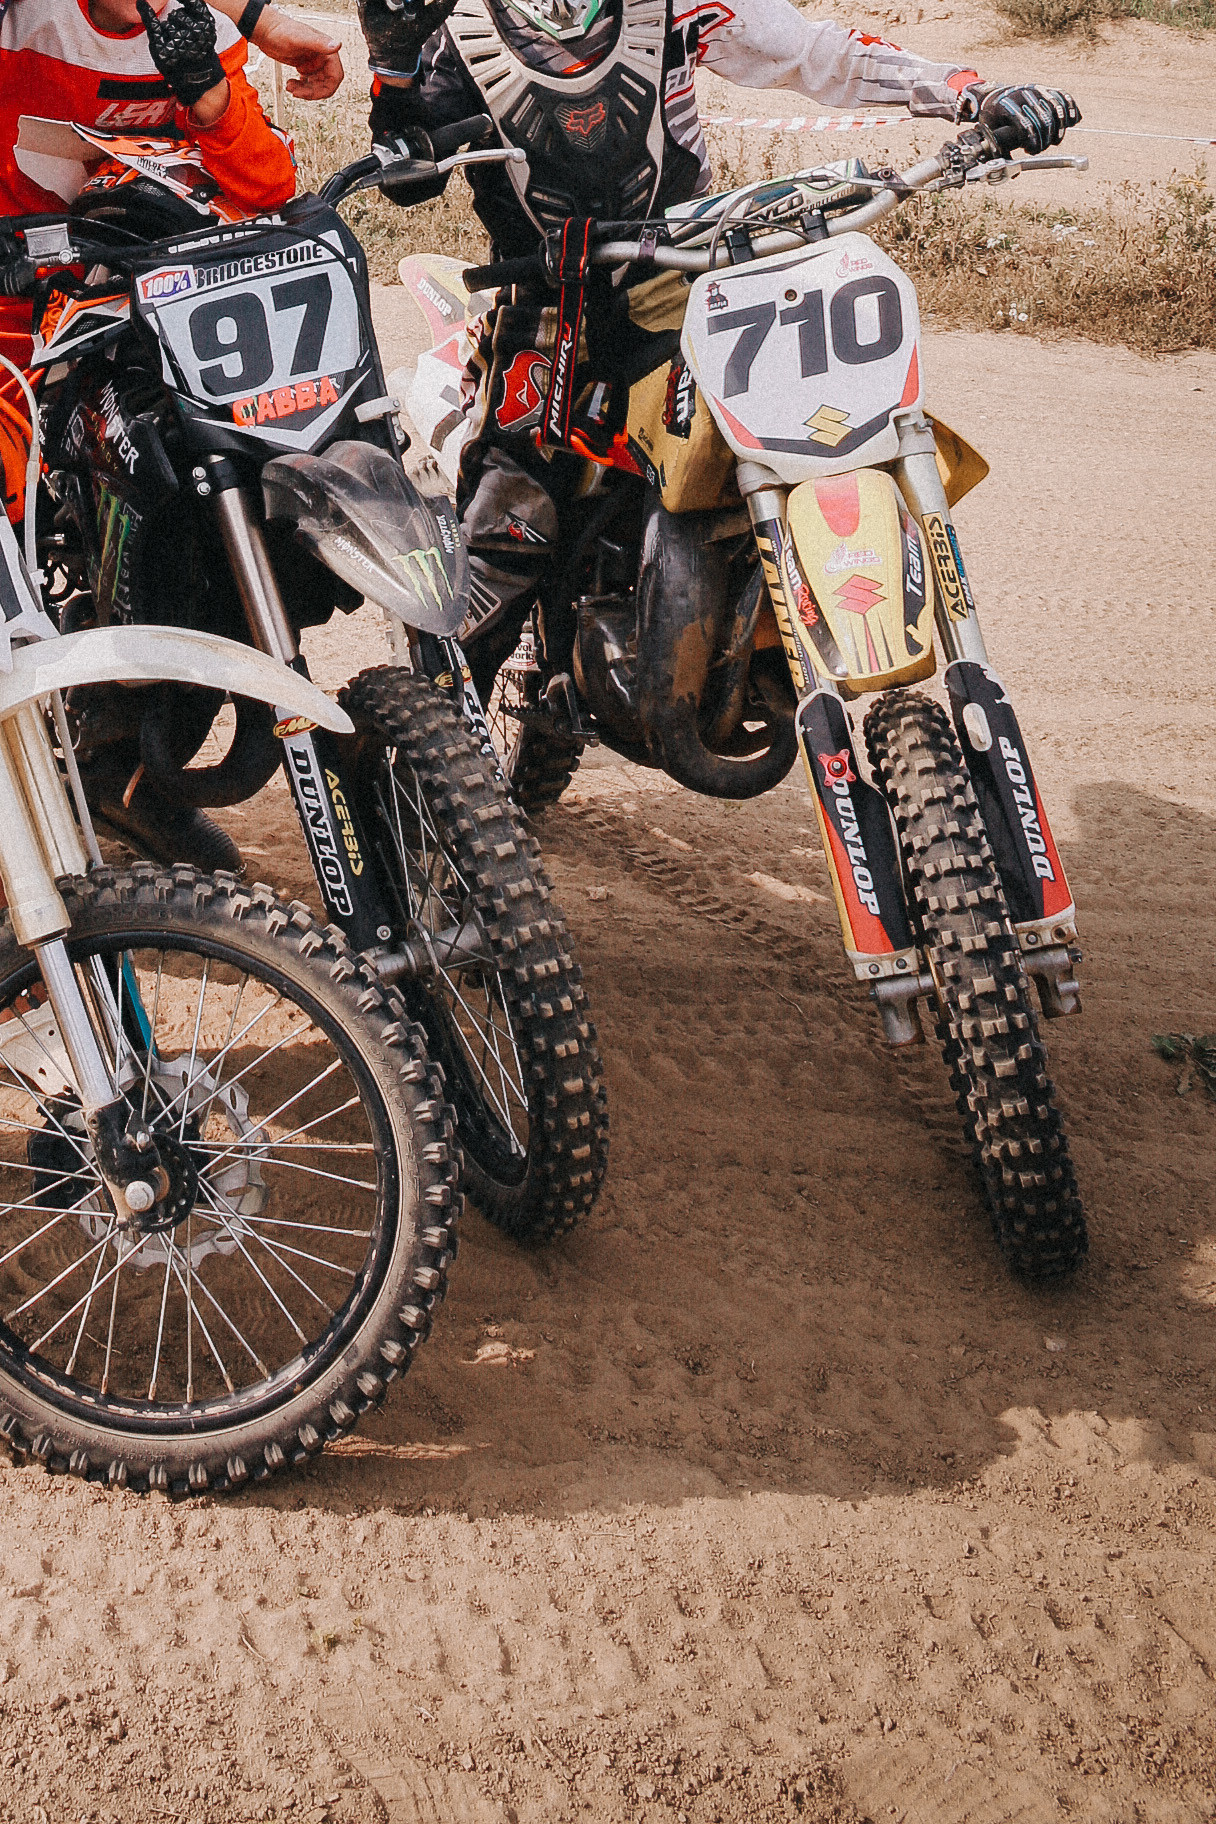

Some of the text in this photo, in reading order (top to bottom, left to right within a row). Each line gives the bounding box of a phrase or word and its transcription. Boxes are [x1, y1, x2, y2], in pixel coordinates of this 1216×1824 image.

[145, 270, 188, 298] 100%
[196, 245, 322, 287] BRIDGESTONE
[417, 277, 453, 318] DUNLOP
[188, 272, 333, 396] 97
[707, 275, 903, 399] 710
[100, 380, 140, 475] MONTER
[334, 536, 377, 573] MONSTER
[785, 534, 803, 590] Team
[906, 534, 923, 597] Team
[928, 516, 968, 618] ACERBIS
[289, 745, 354, 916] DUNLOP
[325, 768, 364, 876] ACERBIS
[832, 778, 880, 916] DUNLOP
[998, 736, 1055, 883] DUNLOP
